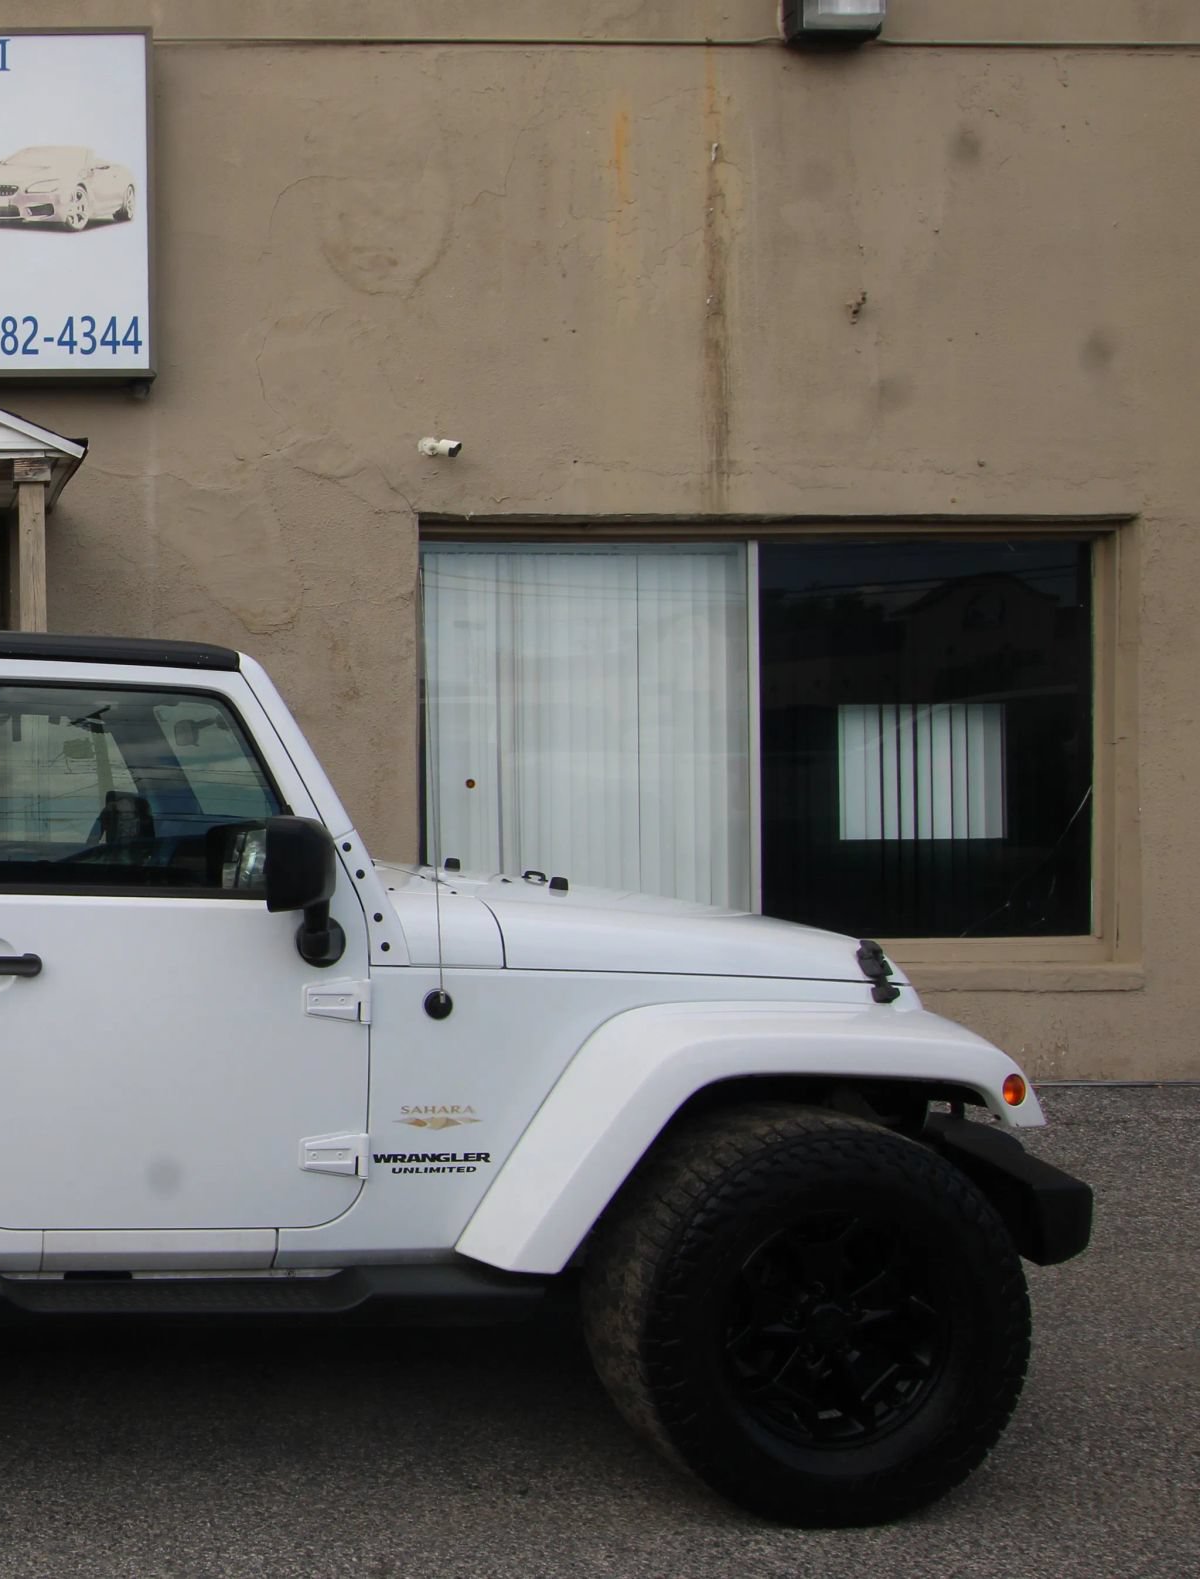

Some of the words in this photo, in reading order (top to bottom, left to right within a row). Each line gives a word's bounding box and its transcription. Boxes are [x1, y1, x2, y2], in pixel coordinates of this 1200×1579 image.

[400, 1105, 476, 1114] SAHARA
[373, 1152, 491, 1163] WRANGLER
[391, 1166, 477, 1174] UNLIMITED
